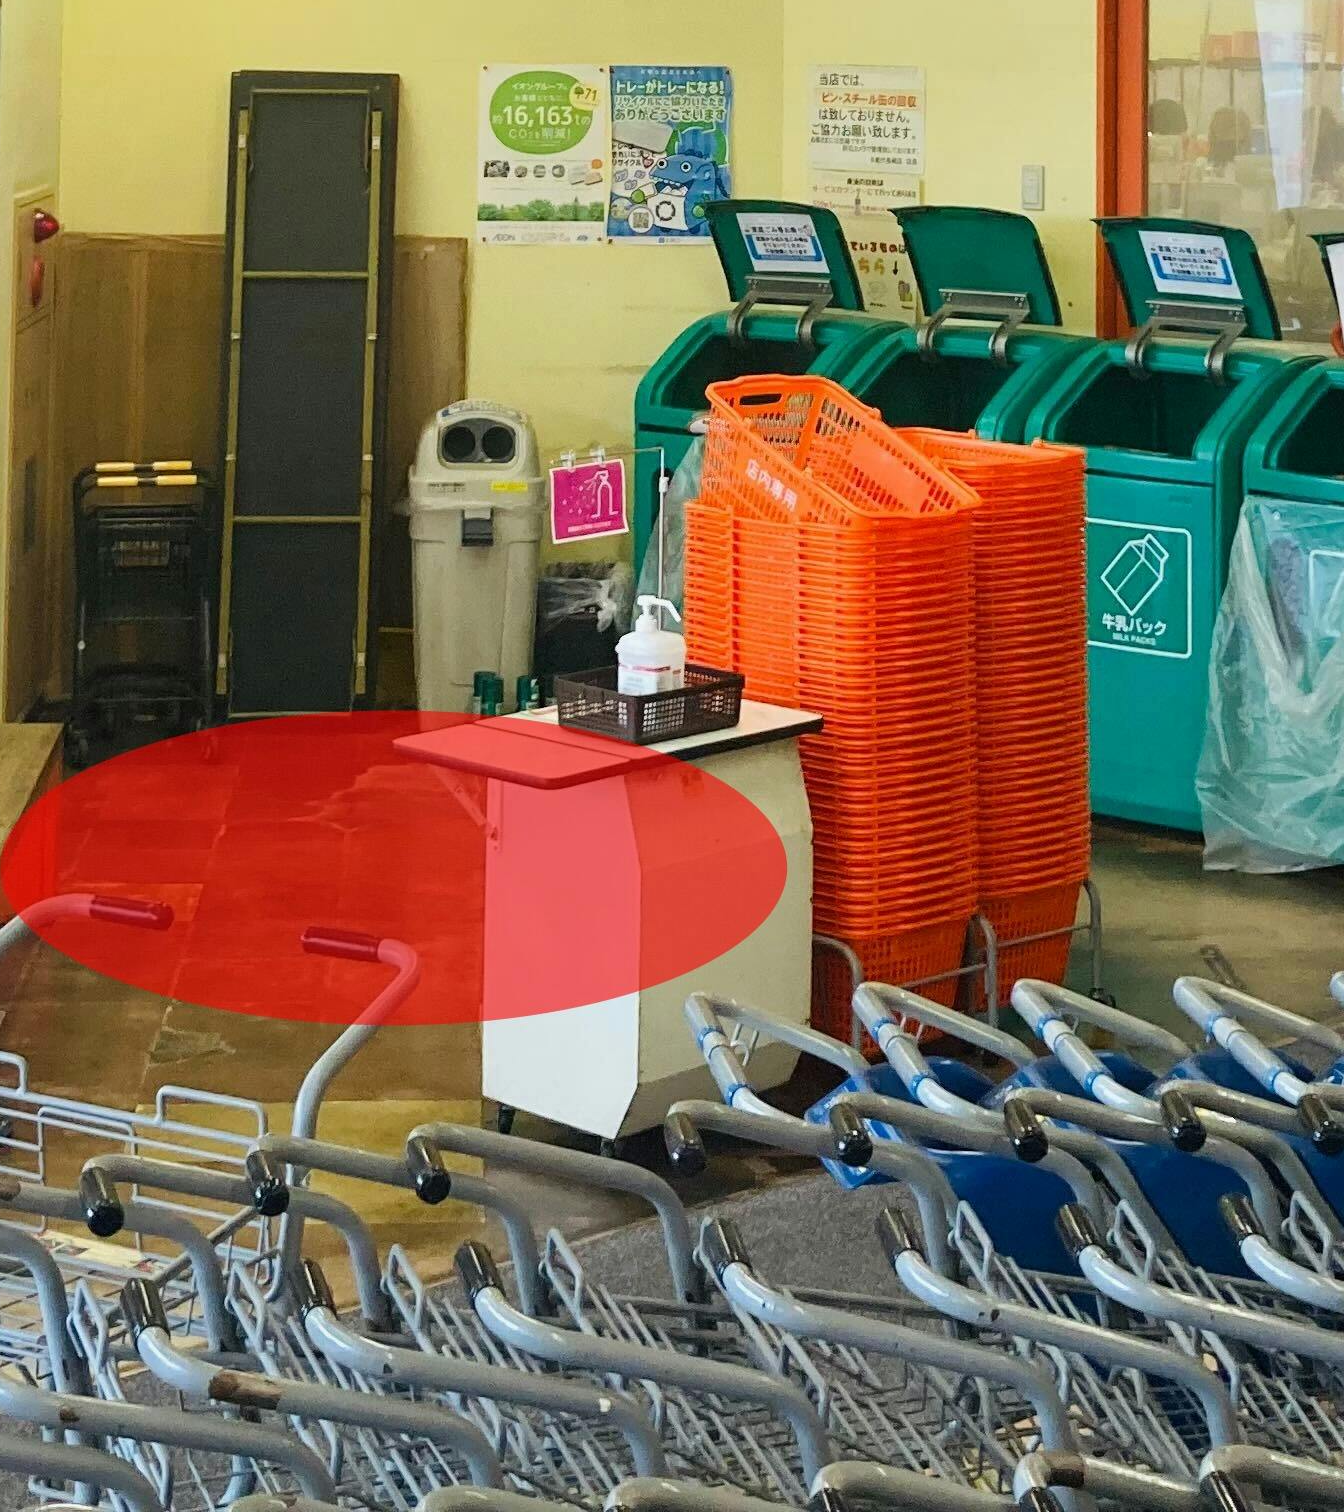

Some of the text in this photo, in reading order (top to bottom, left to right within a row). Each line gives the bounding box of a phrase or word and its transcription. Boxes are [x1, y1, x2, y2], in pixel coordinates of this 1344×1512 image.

[584, 87, 598, 101] 71
[615, 80, 726, 95] トレーがトレーになる!
[745, 458, 798, 513] 店内専用
[1101, 612, 1167, 636] 牛乳パック
